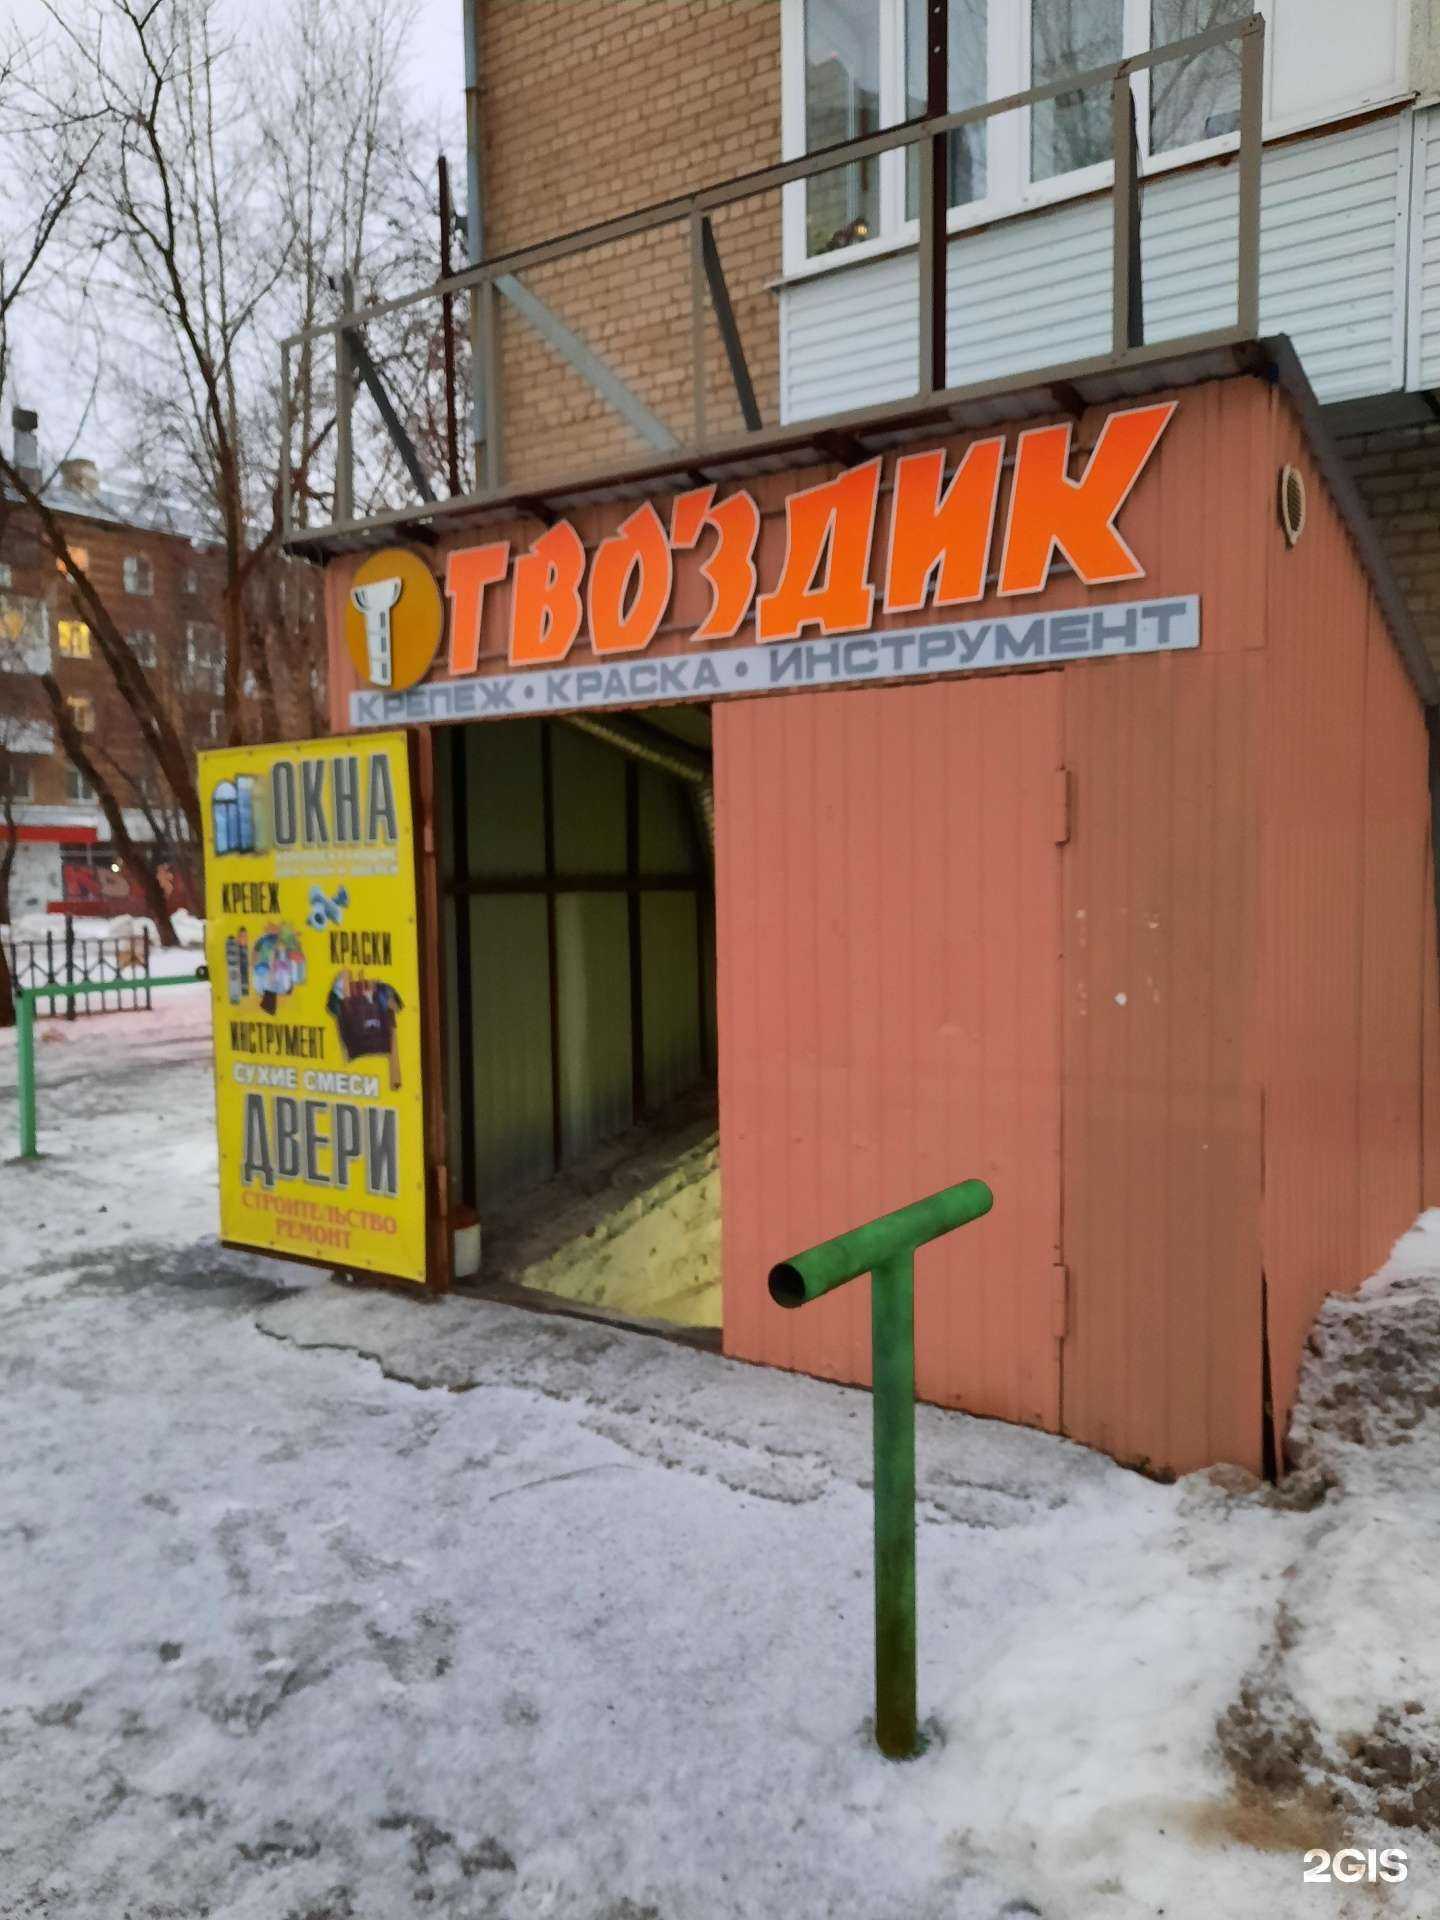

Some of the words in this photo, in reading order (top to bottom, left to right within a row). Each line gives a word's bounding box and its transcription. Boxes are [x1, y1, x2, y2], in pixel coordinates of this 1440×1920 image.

[357, 680, 514, 722] КРЕПЕЖ
[546, 658, 721, 714] КРАСКА
[769, 602, 1187, 683] ИНСТРУМЕНТ
[272, 754, 398, 845] ОКНА
[222, 880, 281, 915] КРЕПЕЖ
[330, 930, 393, 966] КРАСКИ
[232, 1062, 297, 1090] СУХИЕ
[303, 1069, 380, 1097] СМЕСИ
[244, 1093, 398, 1195] ДВЕРИ
[241, 1189, 398, 1235] СТРОИТЕЛЬСТВО
[276, 1217, 351, 1249] РЕМОНТ
